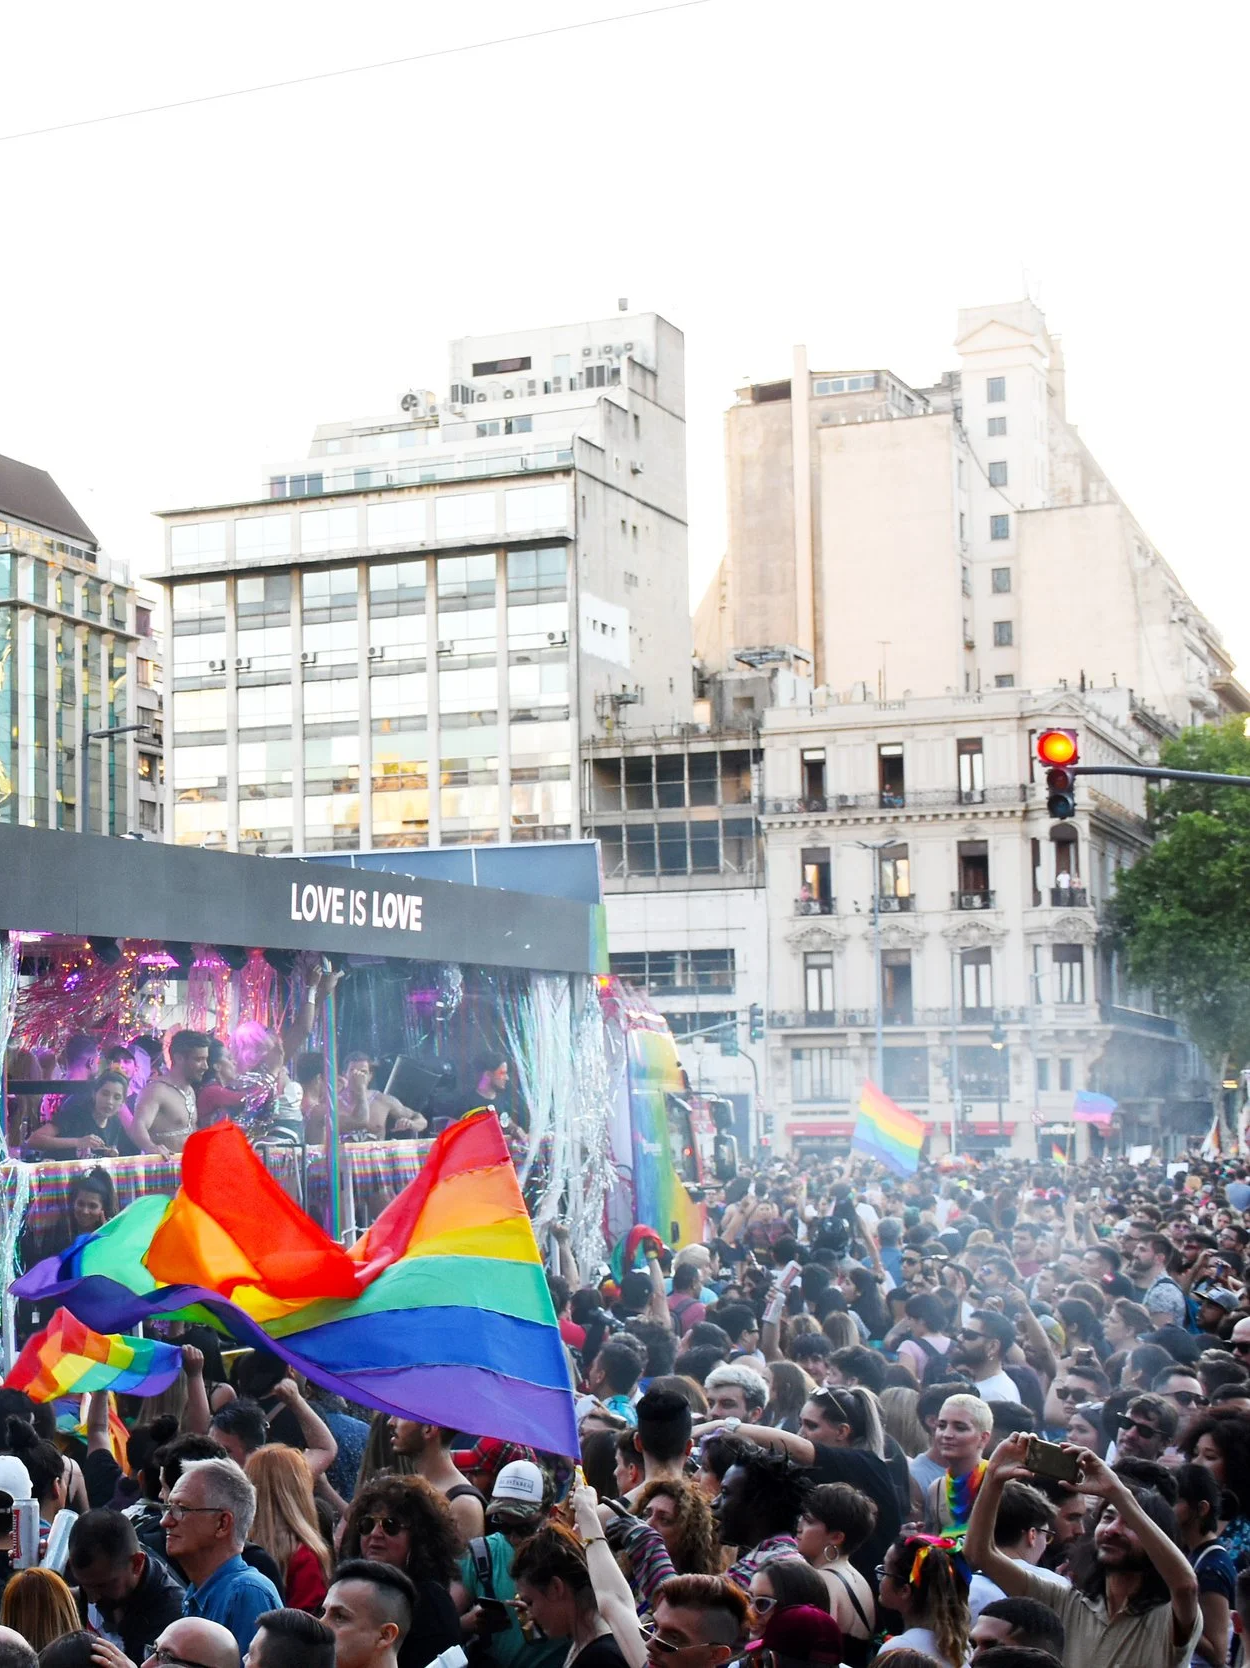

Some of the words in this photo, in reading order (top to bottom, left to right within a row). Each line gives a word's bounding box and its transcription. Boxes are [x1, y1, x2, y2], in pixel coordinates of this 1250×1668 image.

[291, 882, 344, 925] LOVE
[349, 889, 367, 926] IS
[372, 890, 423, 931] LOVE
